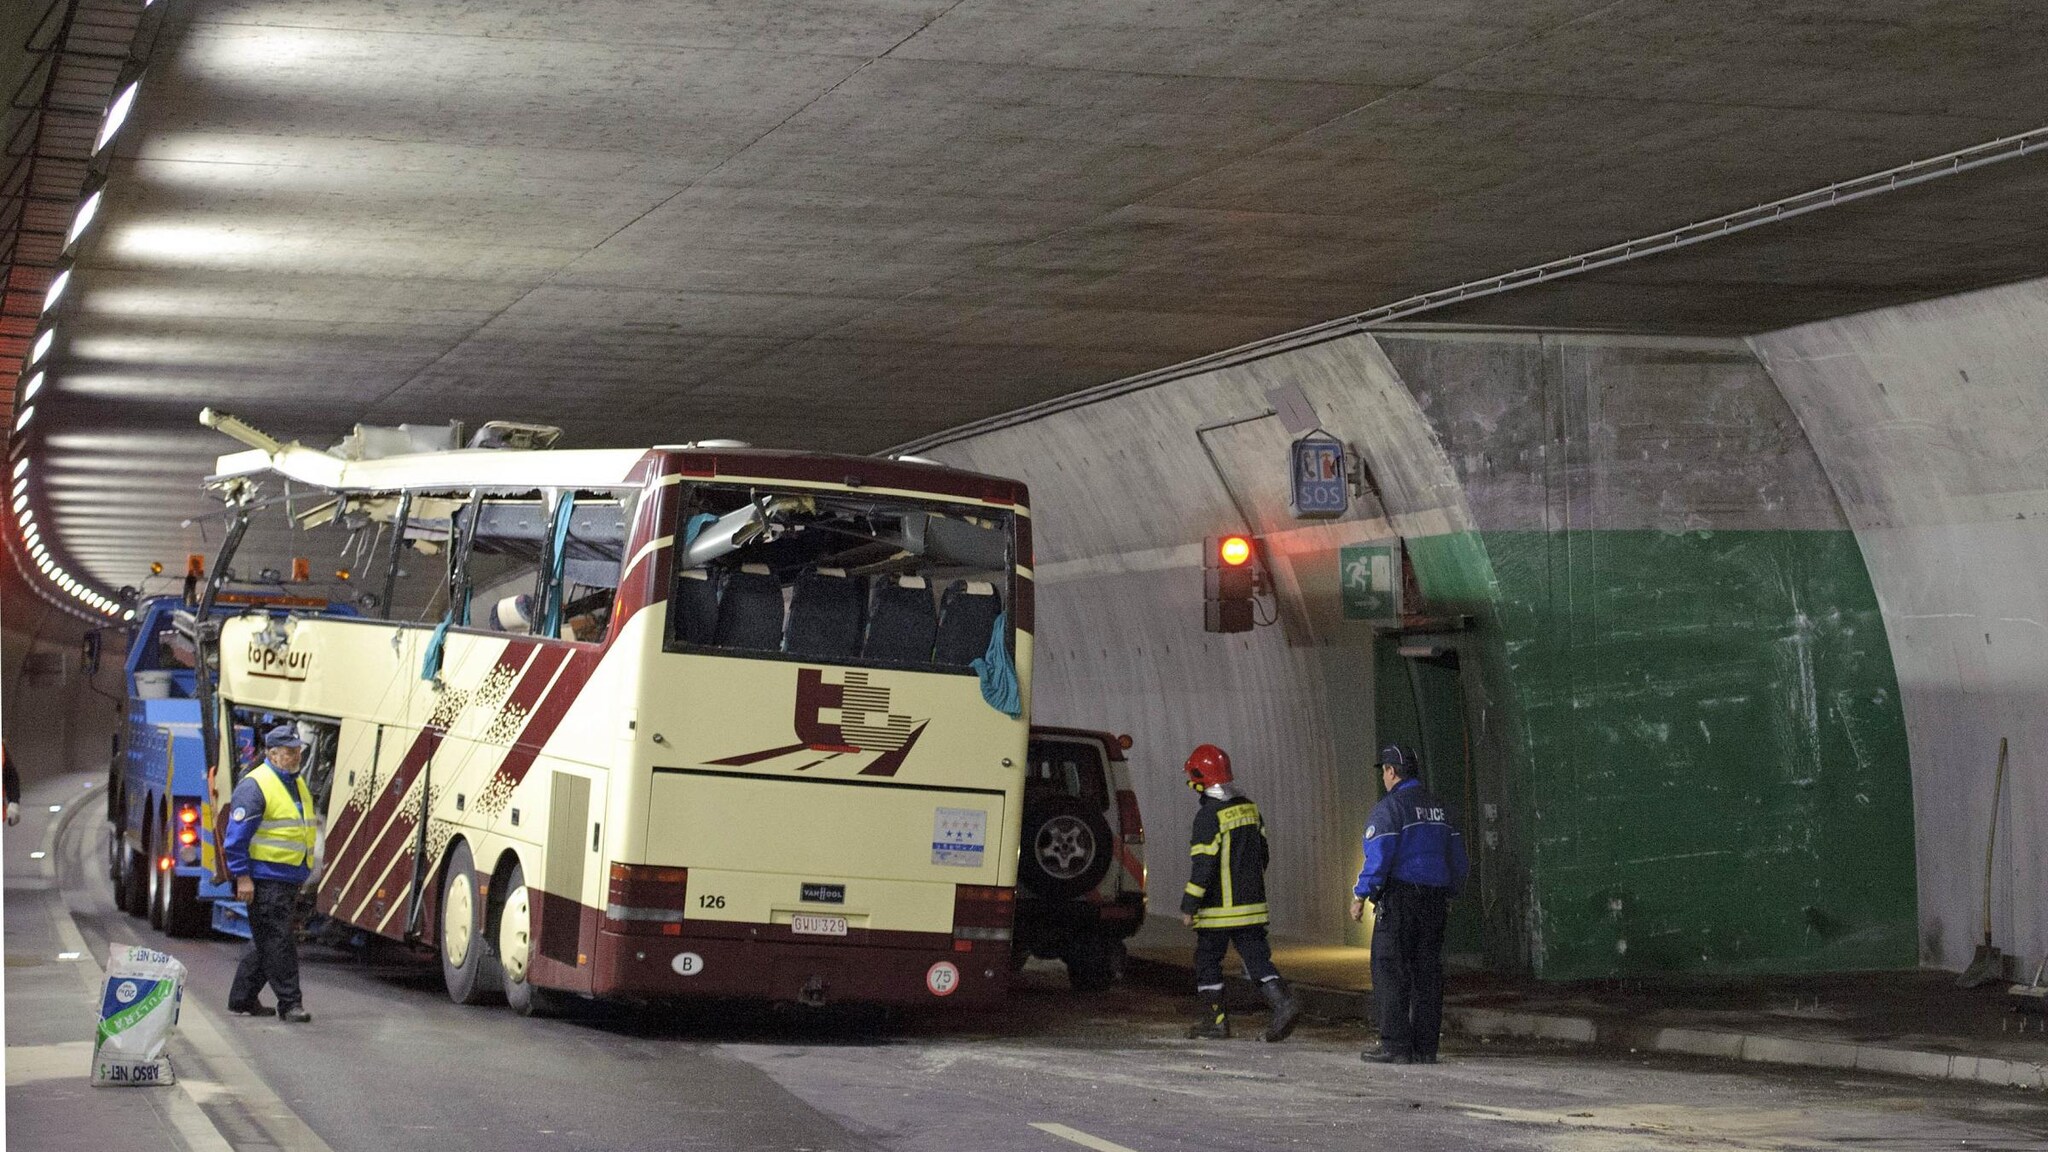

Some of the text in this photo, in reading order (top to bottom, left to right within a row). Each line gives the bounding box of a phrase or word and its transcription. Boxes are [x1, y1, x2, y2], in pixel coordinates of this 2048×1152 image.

[1302, 486, 1340, 504] SOS
[699, 895, 726, 909] 126
[794, 917, 845, 933] GWU 329
[683, 957, 693, 971] B
[935, 970, 952, 983] 75
[124, 989, 135, 998] 20
[114, 997, 157, 1029] ULTRA
